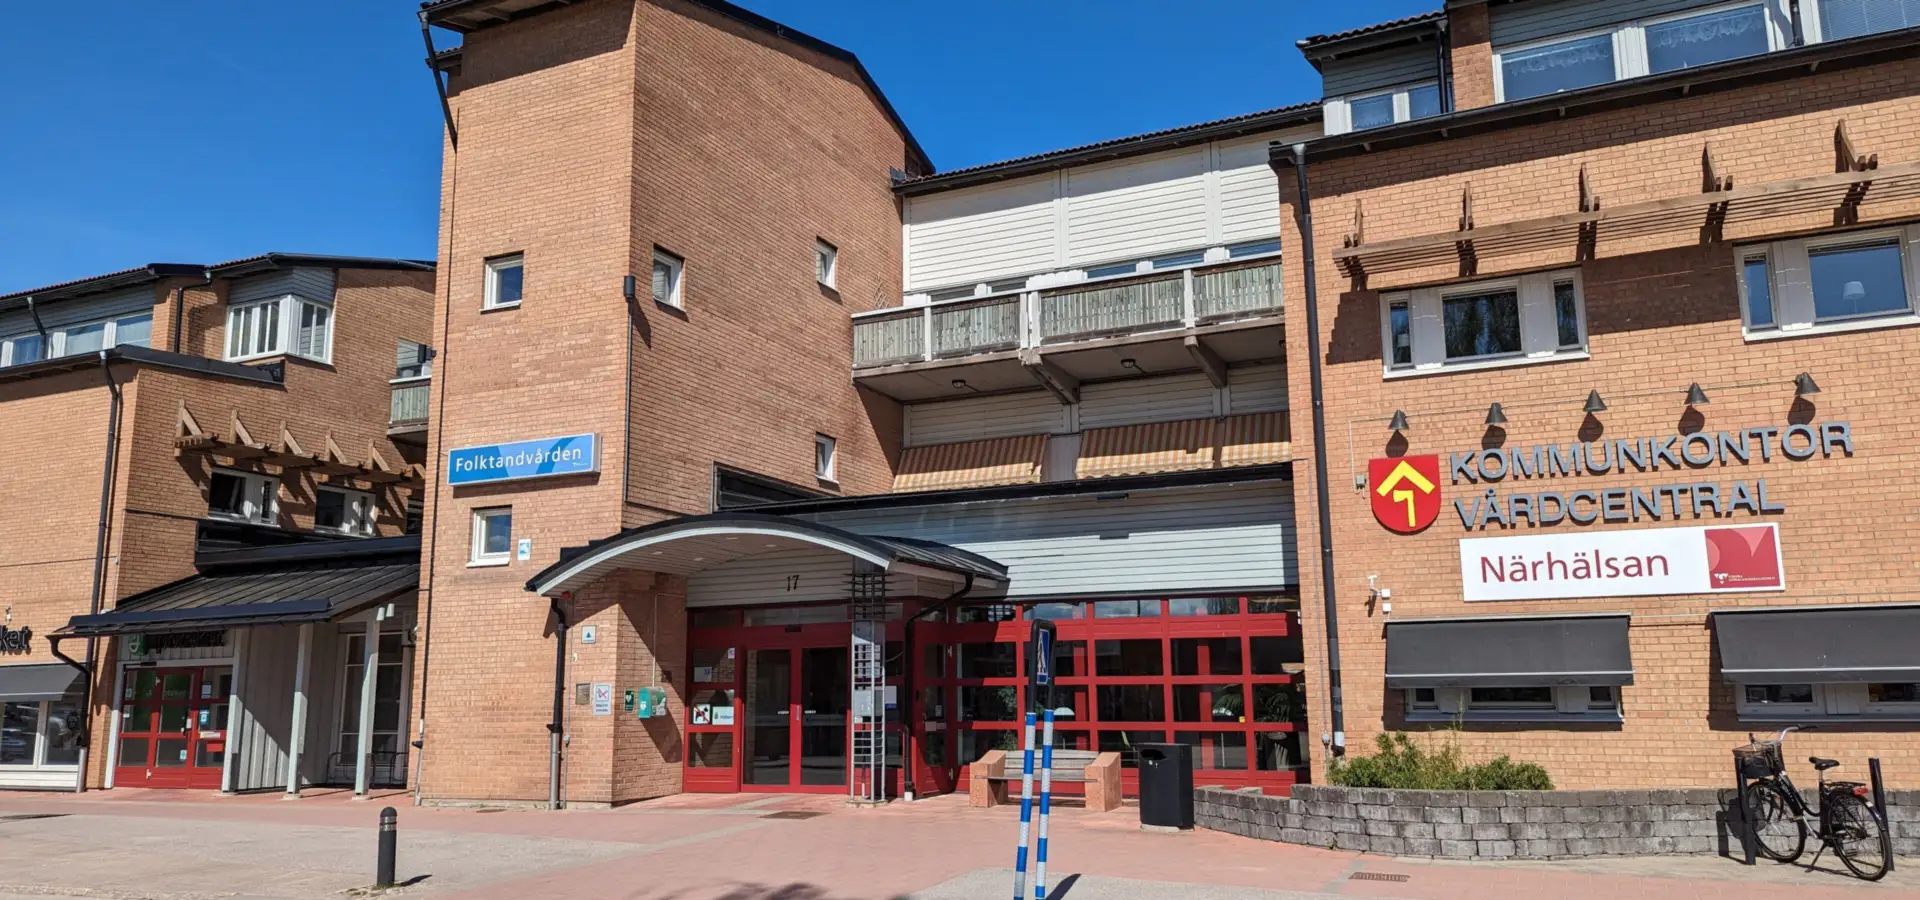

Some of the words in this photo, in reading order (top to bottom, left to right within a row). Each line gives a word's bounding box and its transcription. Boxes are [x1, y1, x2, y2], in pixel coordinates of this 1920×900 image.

[455, 446, 581, 473] Folktandvården
[1450, 421, 1853, 485] KOMMUNKONTOR
[1455, 478, 1785, 532] VÅRDCENTRAL
[787, 574, 800, 592] 17
[1480, 549, 1669, 583] Närhälsan
